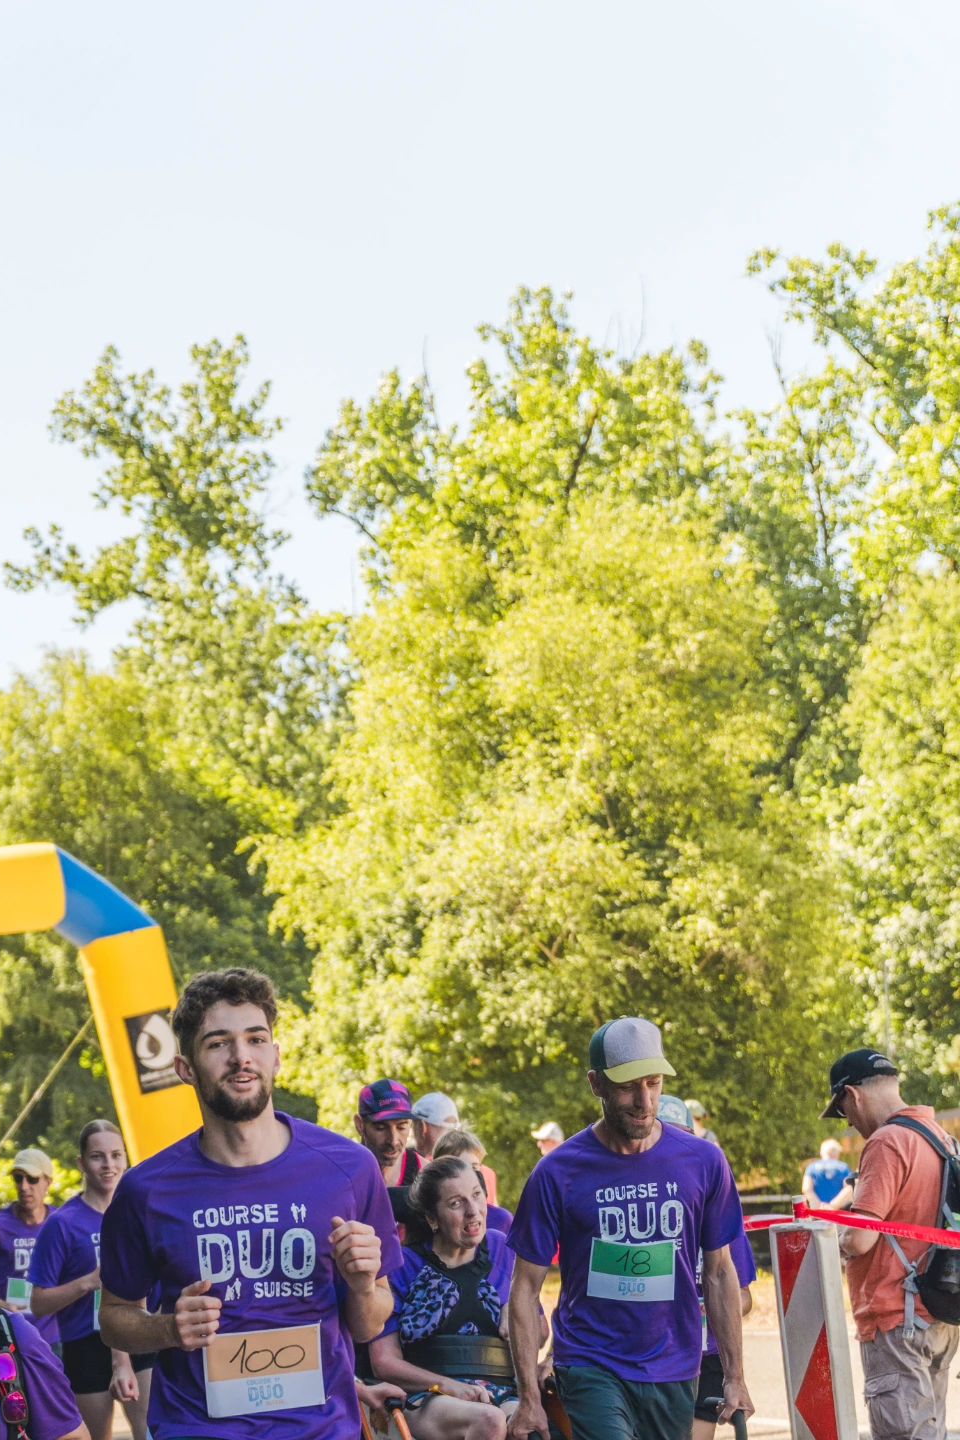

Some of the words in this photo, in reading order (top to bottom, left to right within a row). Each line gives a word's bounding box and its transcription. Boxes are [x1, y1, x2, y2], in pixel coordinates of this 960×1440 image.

[596, 1183, 658, 1203] COURSE
[192, 1204, 279, 1229] COURSE
[598, 1200, 684, 1242] DUO
[13, 1238, 37, 1247] COUR
[196, 1227, 316, 1284] DUO
[616, 1249, 651, 1275] 18
[253, 1281, 314, 1298] SUISSE
[617, 1282, 646, 1293] DUO
[229, 1339, 306, 1374] 100
[248, 1383, 284, 1402] DUO
